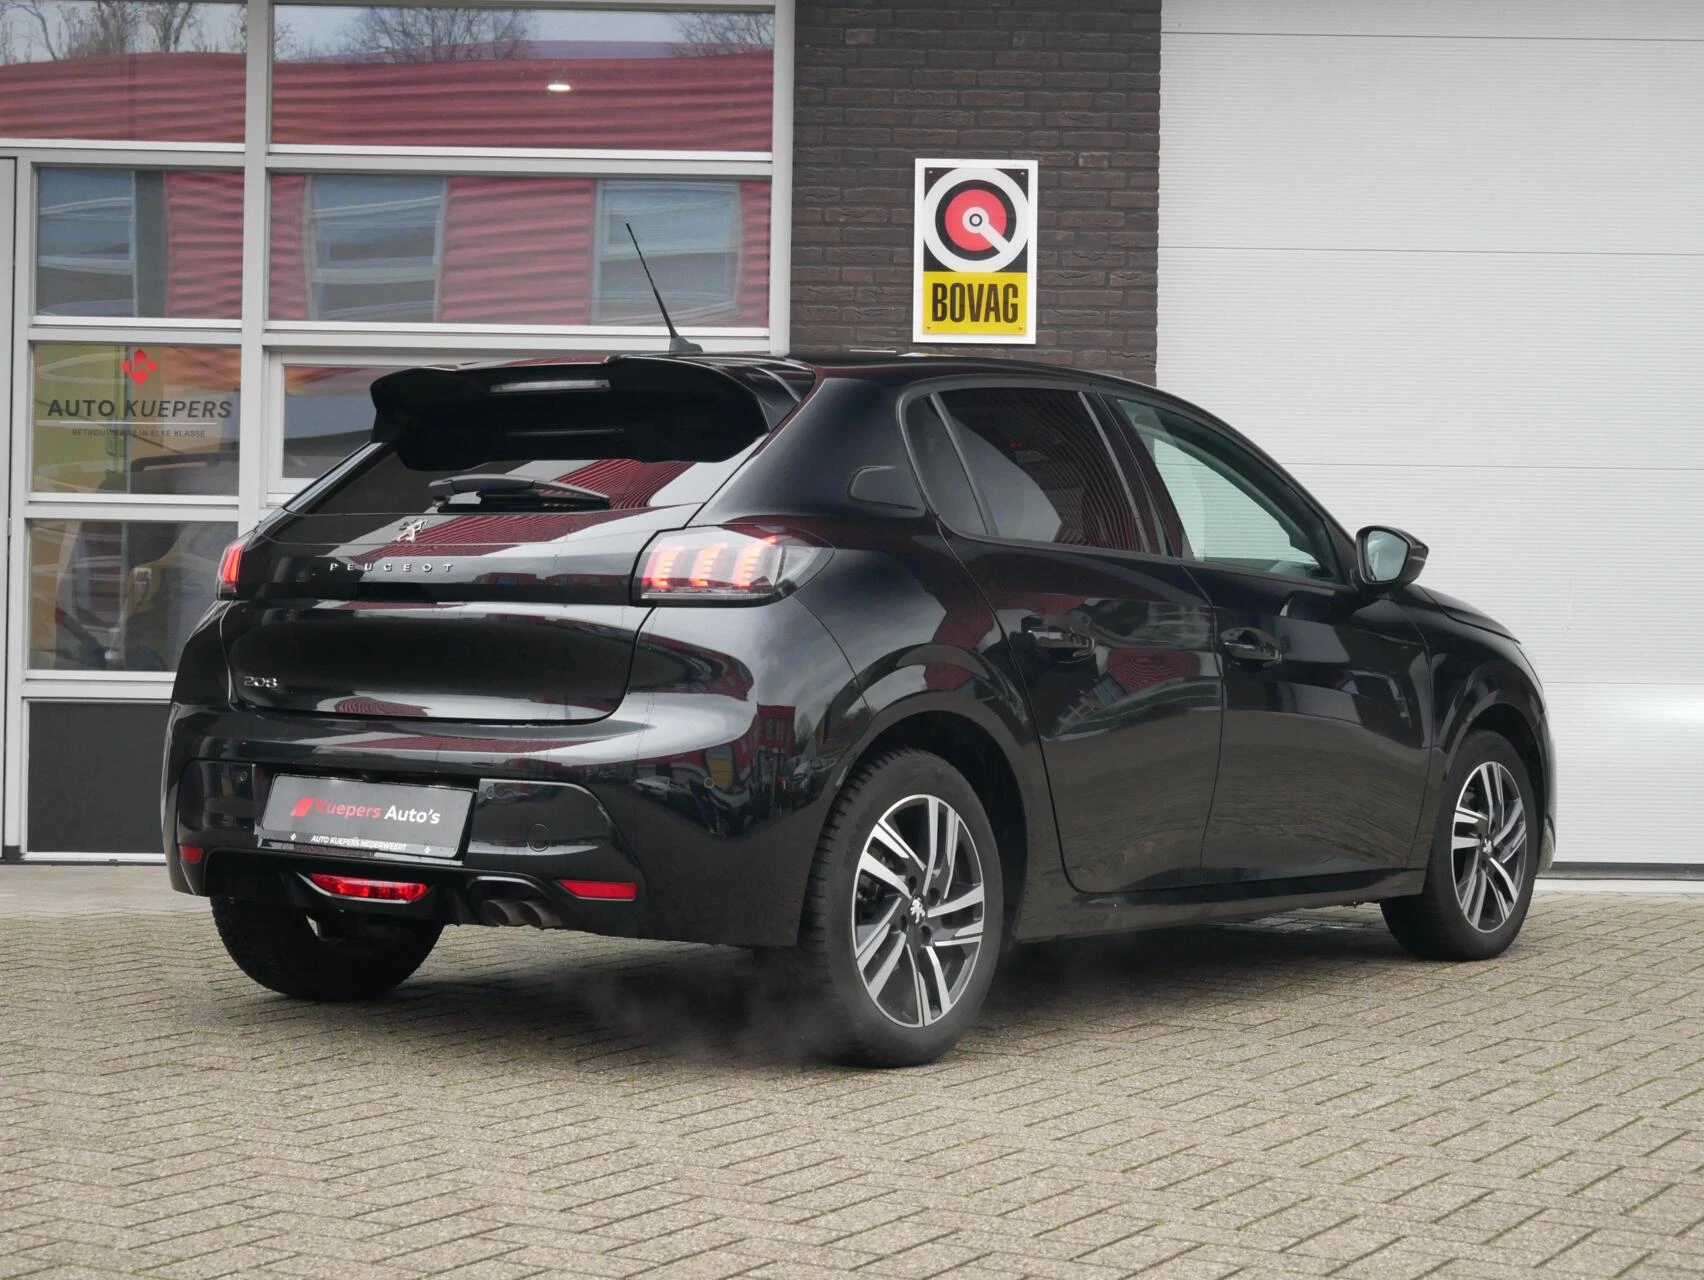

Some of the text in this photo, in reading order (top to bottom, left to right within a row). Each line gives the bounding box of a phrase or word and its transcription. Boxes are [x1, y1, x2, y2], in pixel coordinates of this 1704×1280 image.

[932, 283, 1019, 323] BOVAG
[48, 399, 233, 419] AUTO KUEPERS
[174, 430, 206, 438] KLASSE
[329, 563, 454, 572] PEUGEOT
[243, 676, 278, 688] 208
[314, 800, 441, 825] Kuepers Auto's
[311, 834, 407, 852] AUTO KUEPERS NEDERWEERT
